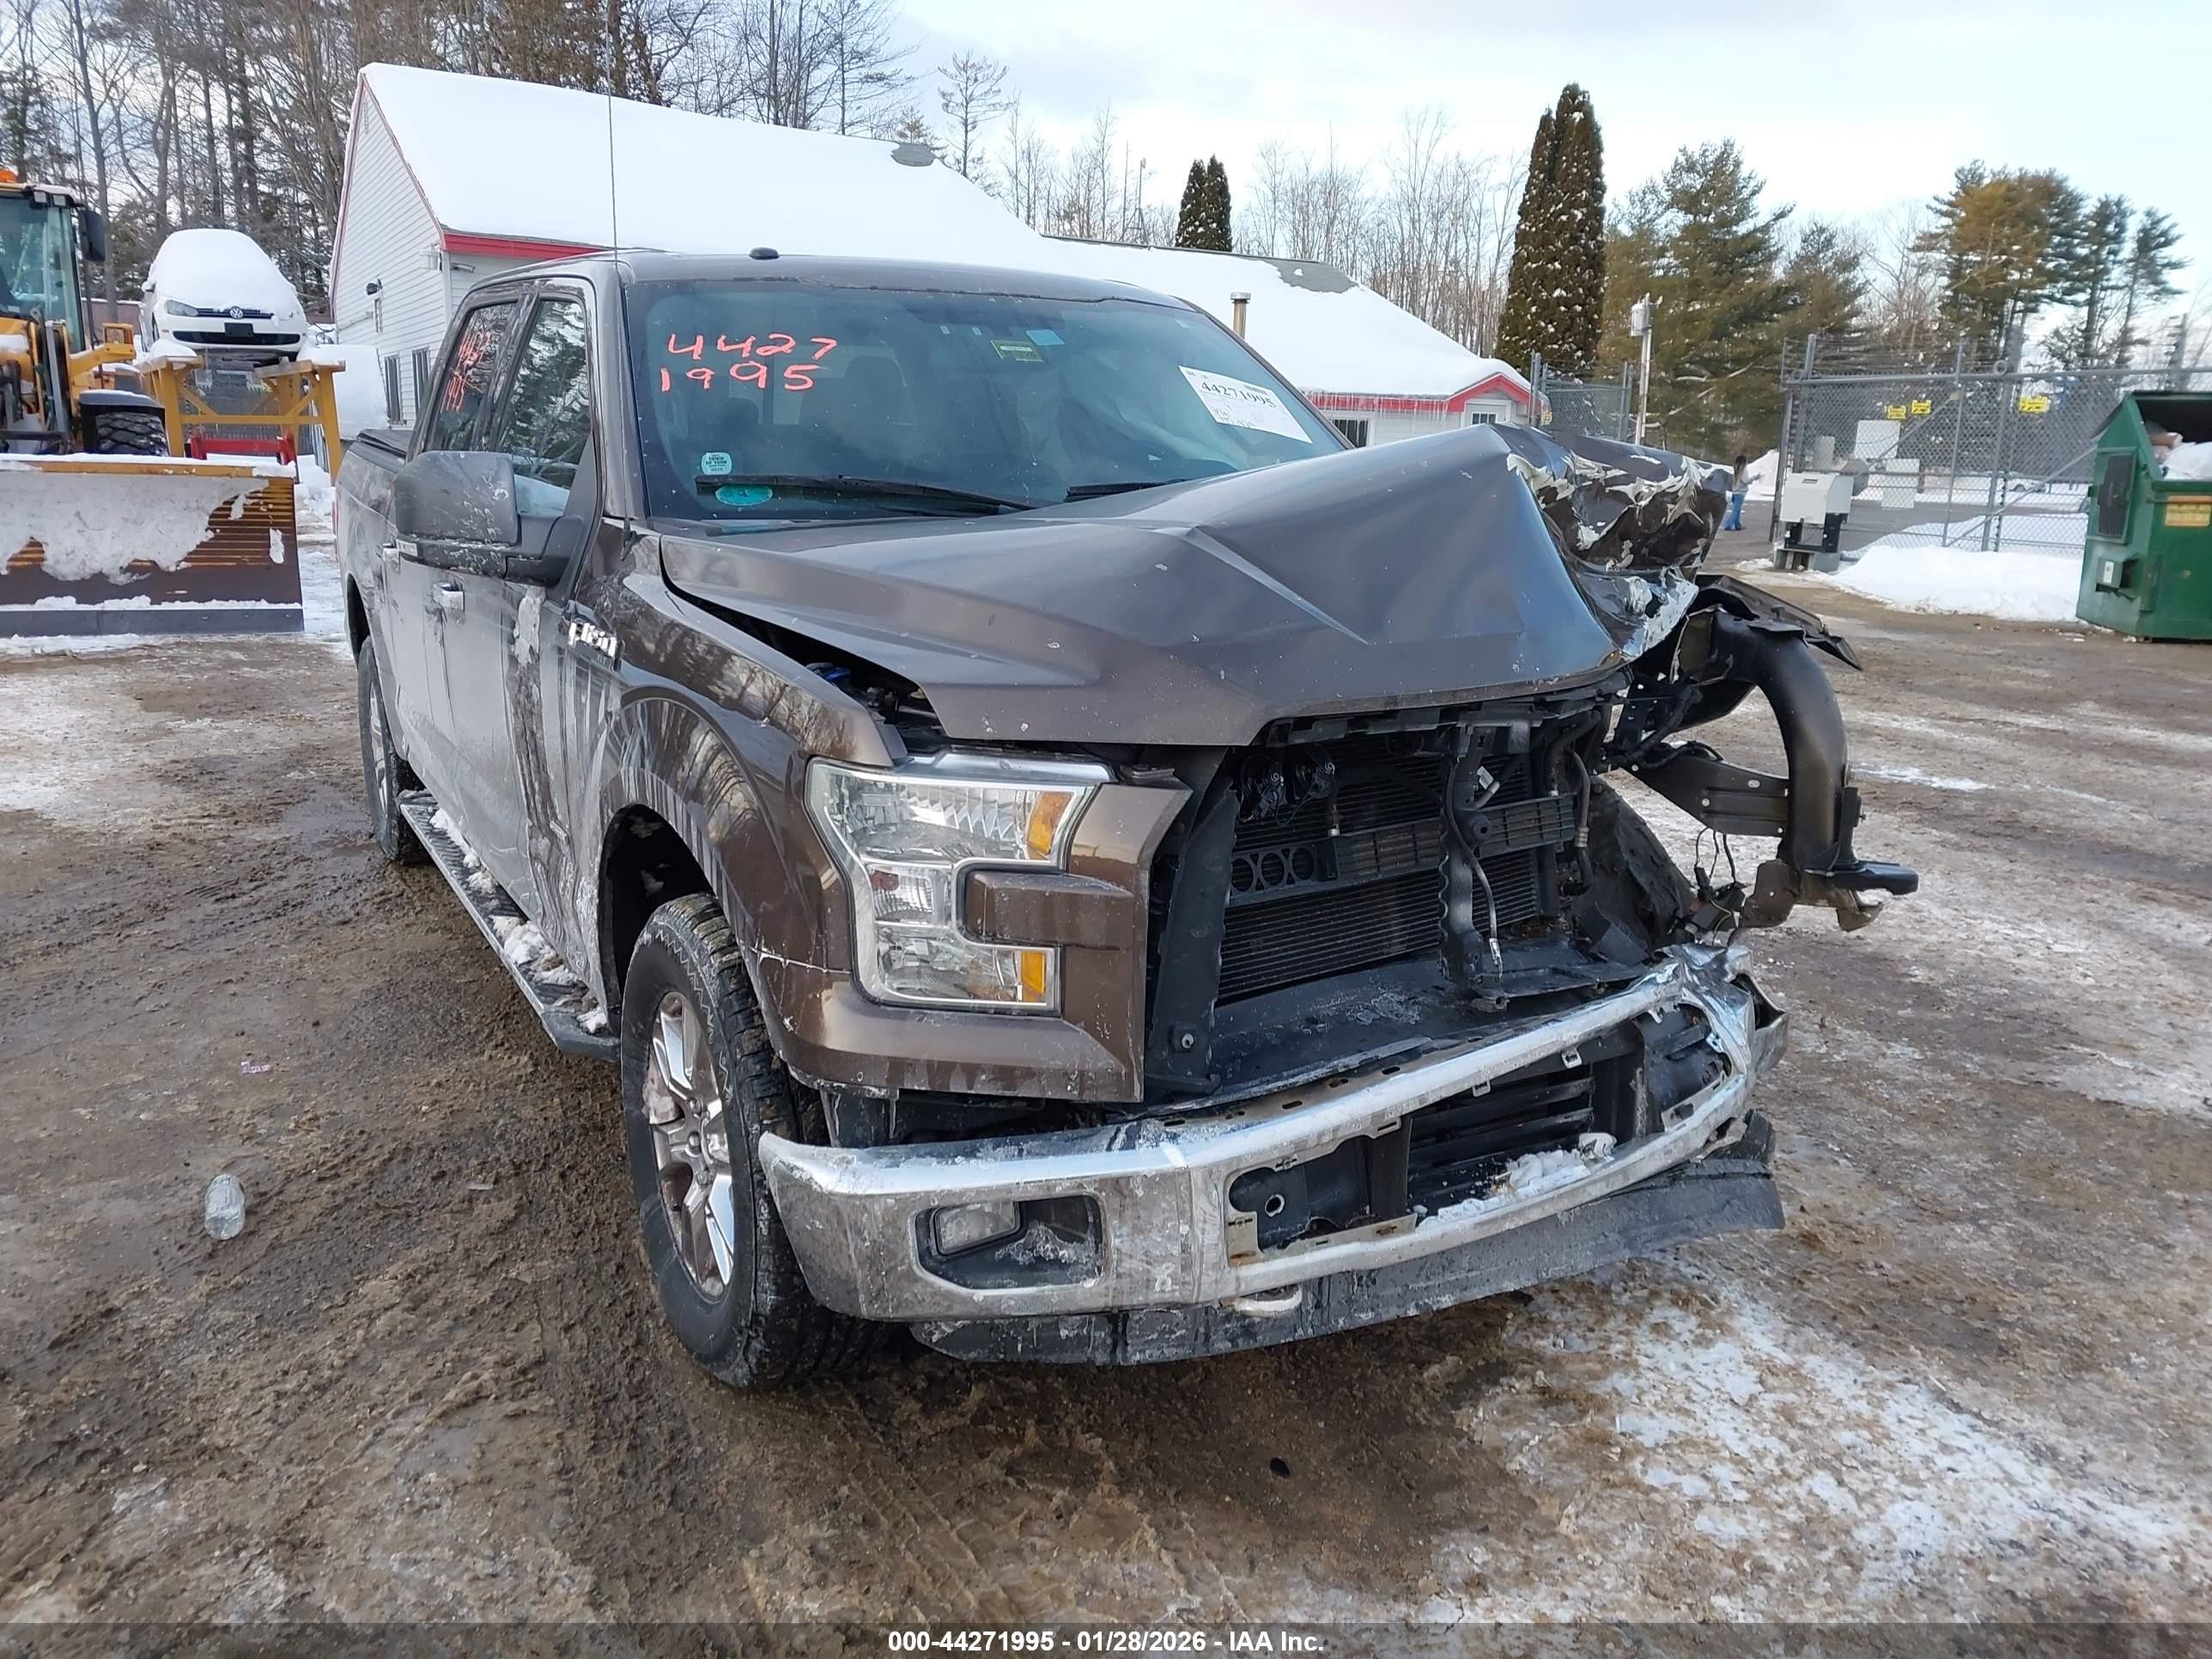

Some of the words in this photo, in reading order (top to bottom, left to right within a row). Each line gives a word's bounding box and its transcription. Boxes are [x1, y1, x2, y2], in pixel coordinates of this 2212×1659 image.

[667, 332, 838, 360] 4427
[659, 361, 823, 392] 1995
[1201, 381, 1276, 409] 44271995
